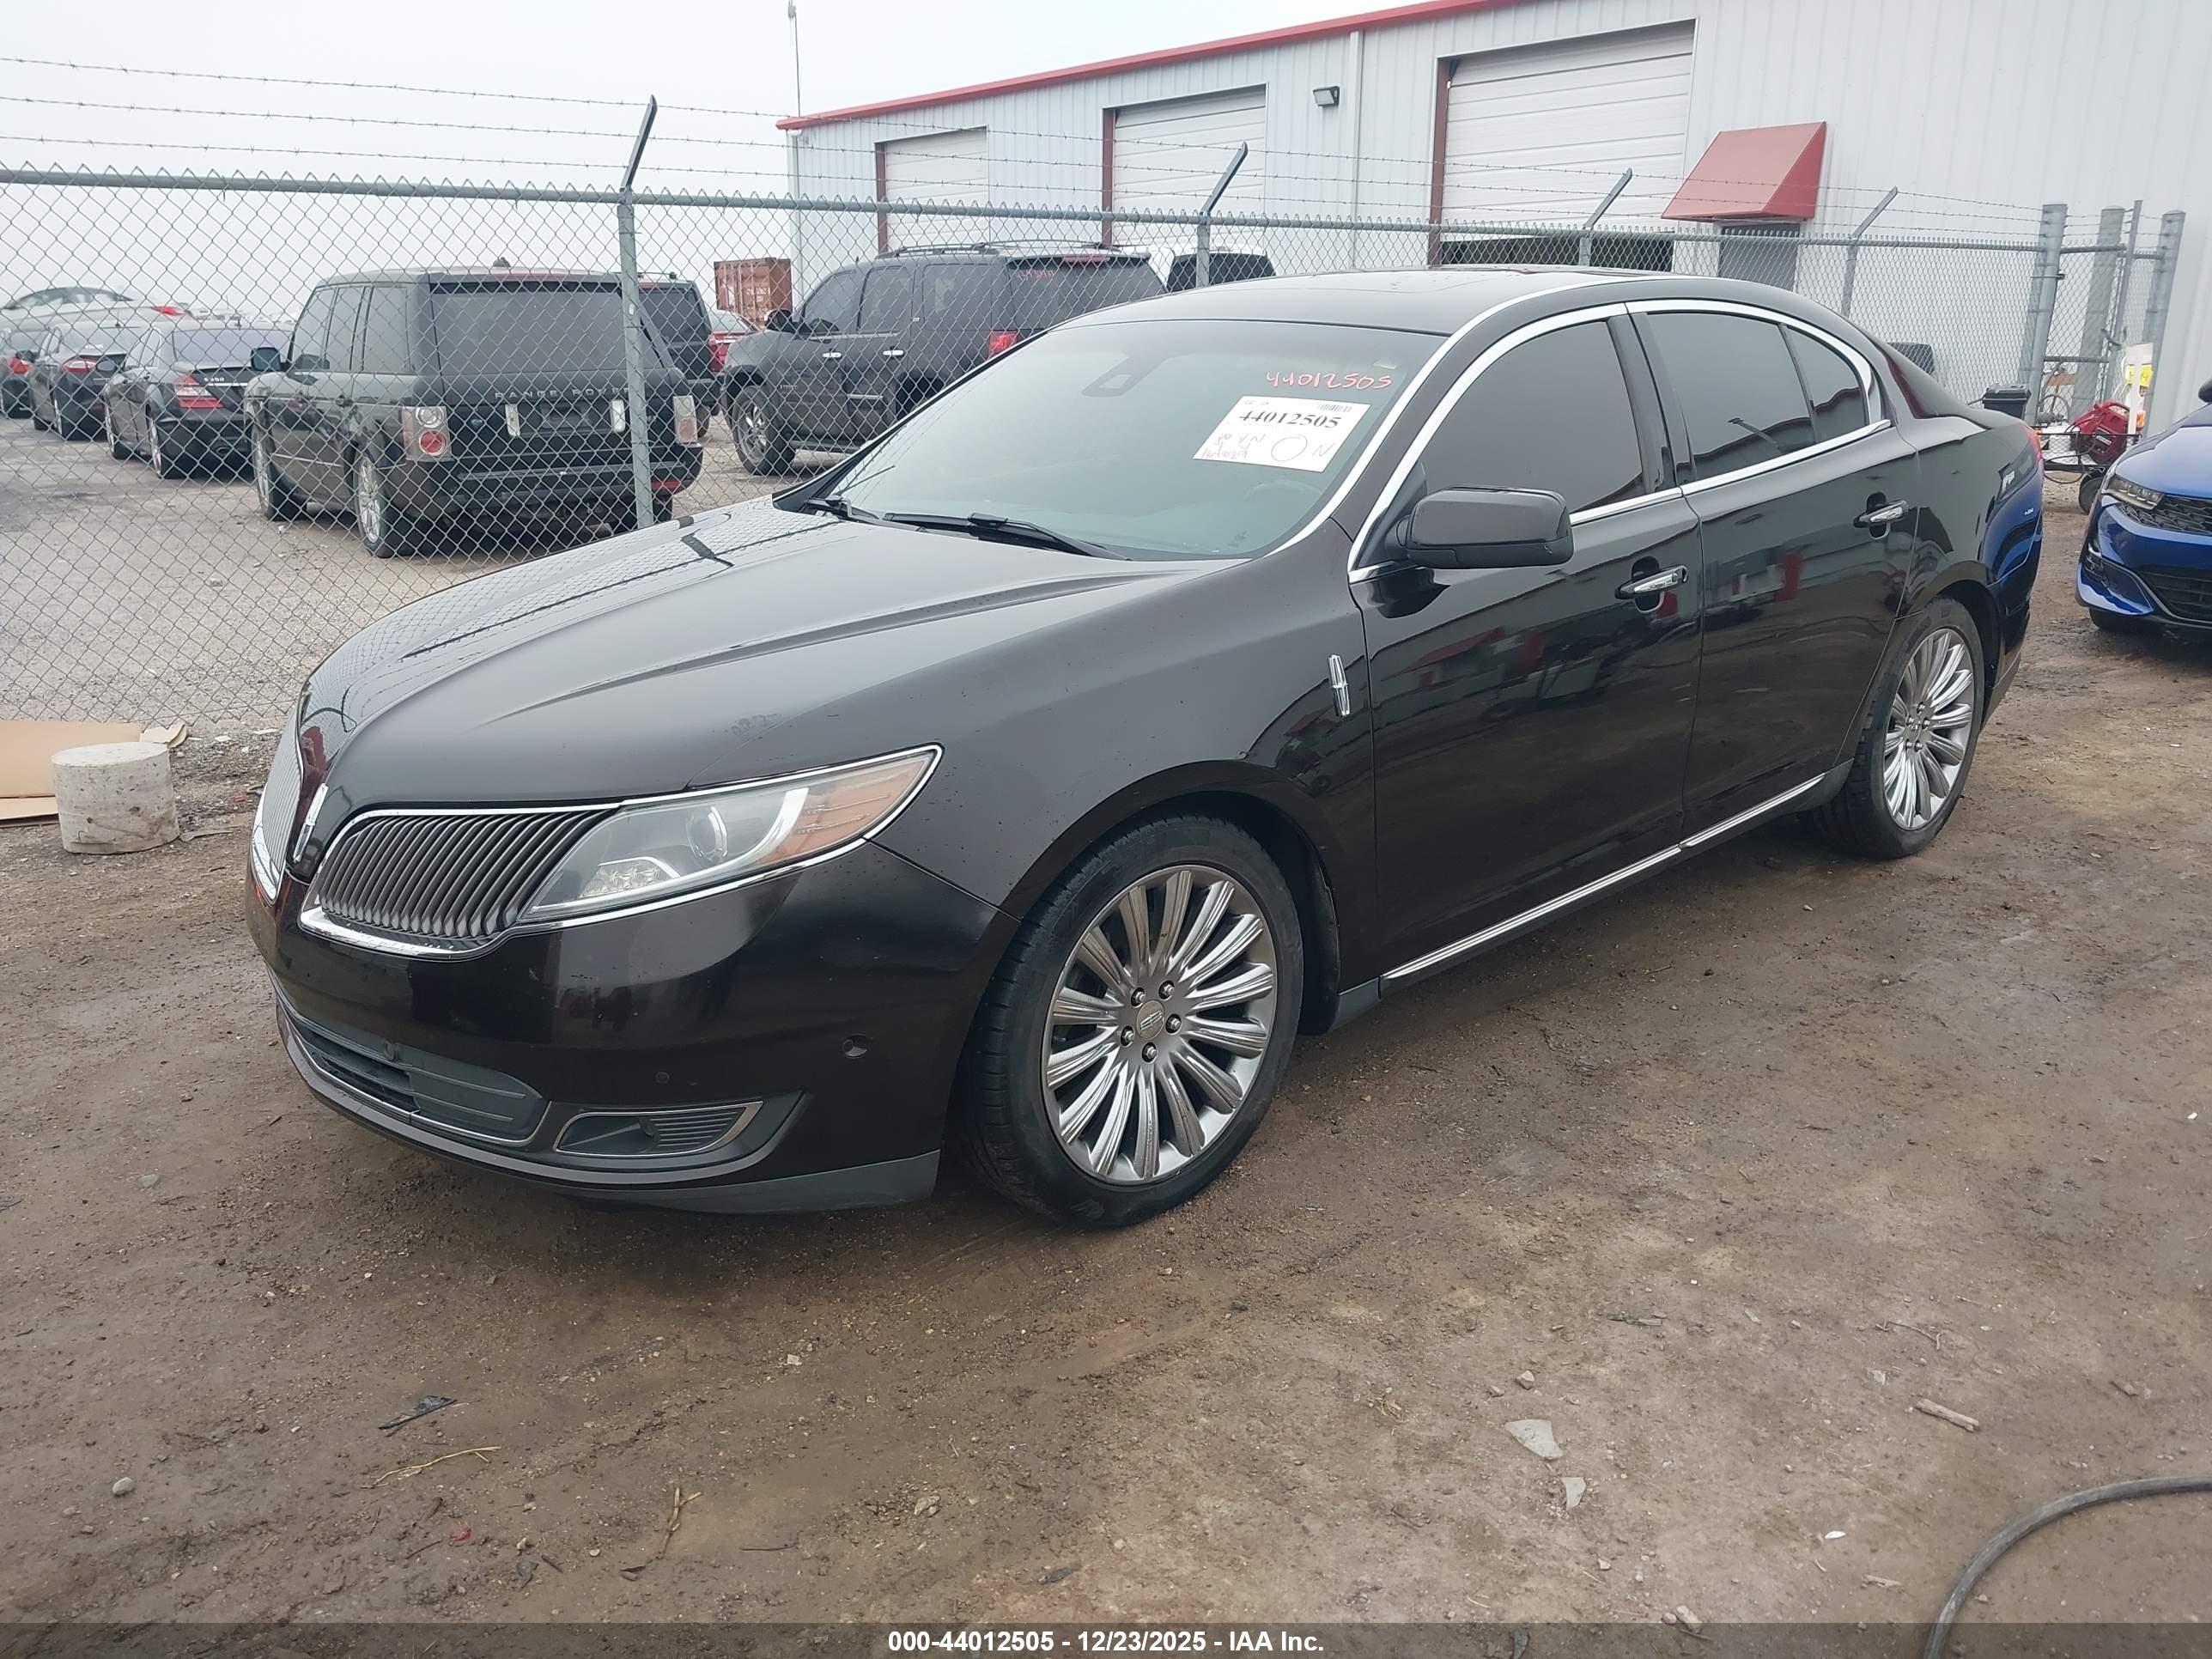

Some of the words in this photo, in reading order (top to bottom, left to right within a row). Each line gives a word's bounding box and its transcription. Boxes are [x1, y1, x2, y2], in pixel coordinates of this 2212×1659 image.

[1267, 371, 1393, 390] 44012505
[495, 390, 557, 399] RANGE
[1239, 410, 1342, 428] 44012505
